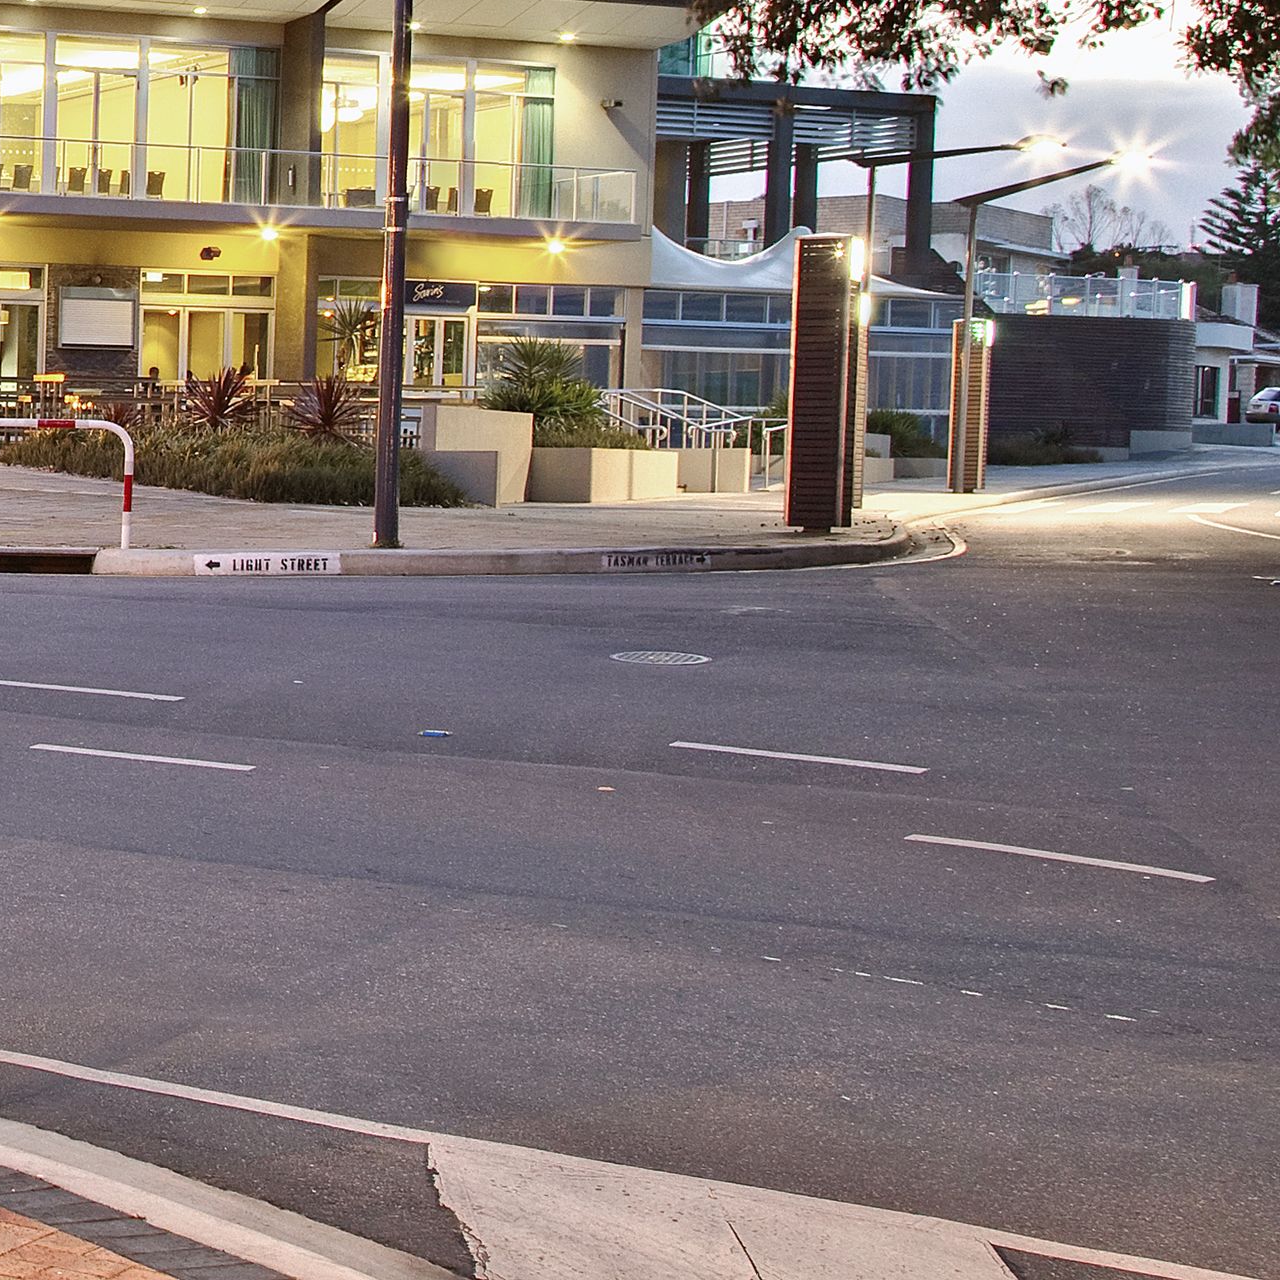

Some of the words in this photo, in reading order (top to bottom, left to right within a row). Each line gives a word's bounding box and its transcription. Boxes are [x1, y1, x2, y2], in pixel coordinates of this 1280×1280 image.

[233, 558, 271, 571] LIGHT
[280, 557, 329, 571] STREET
[607, 554, 649, 568] TASMAN
